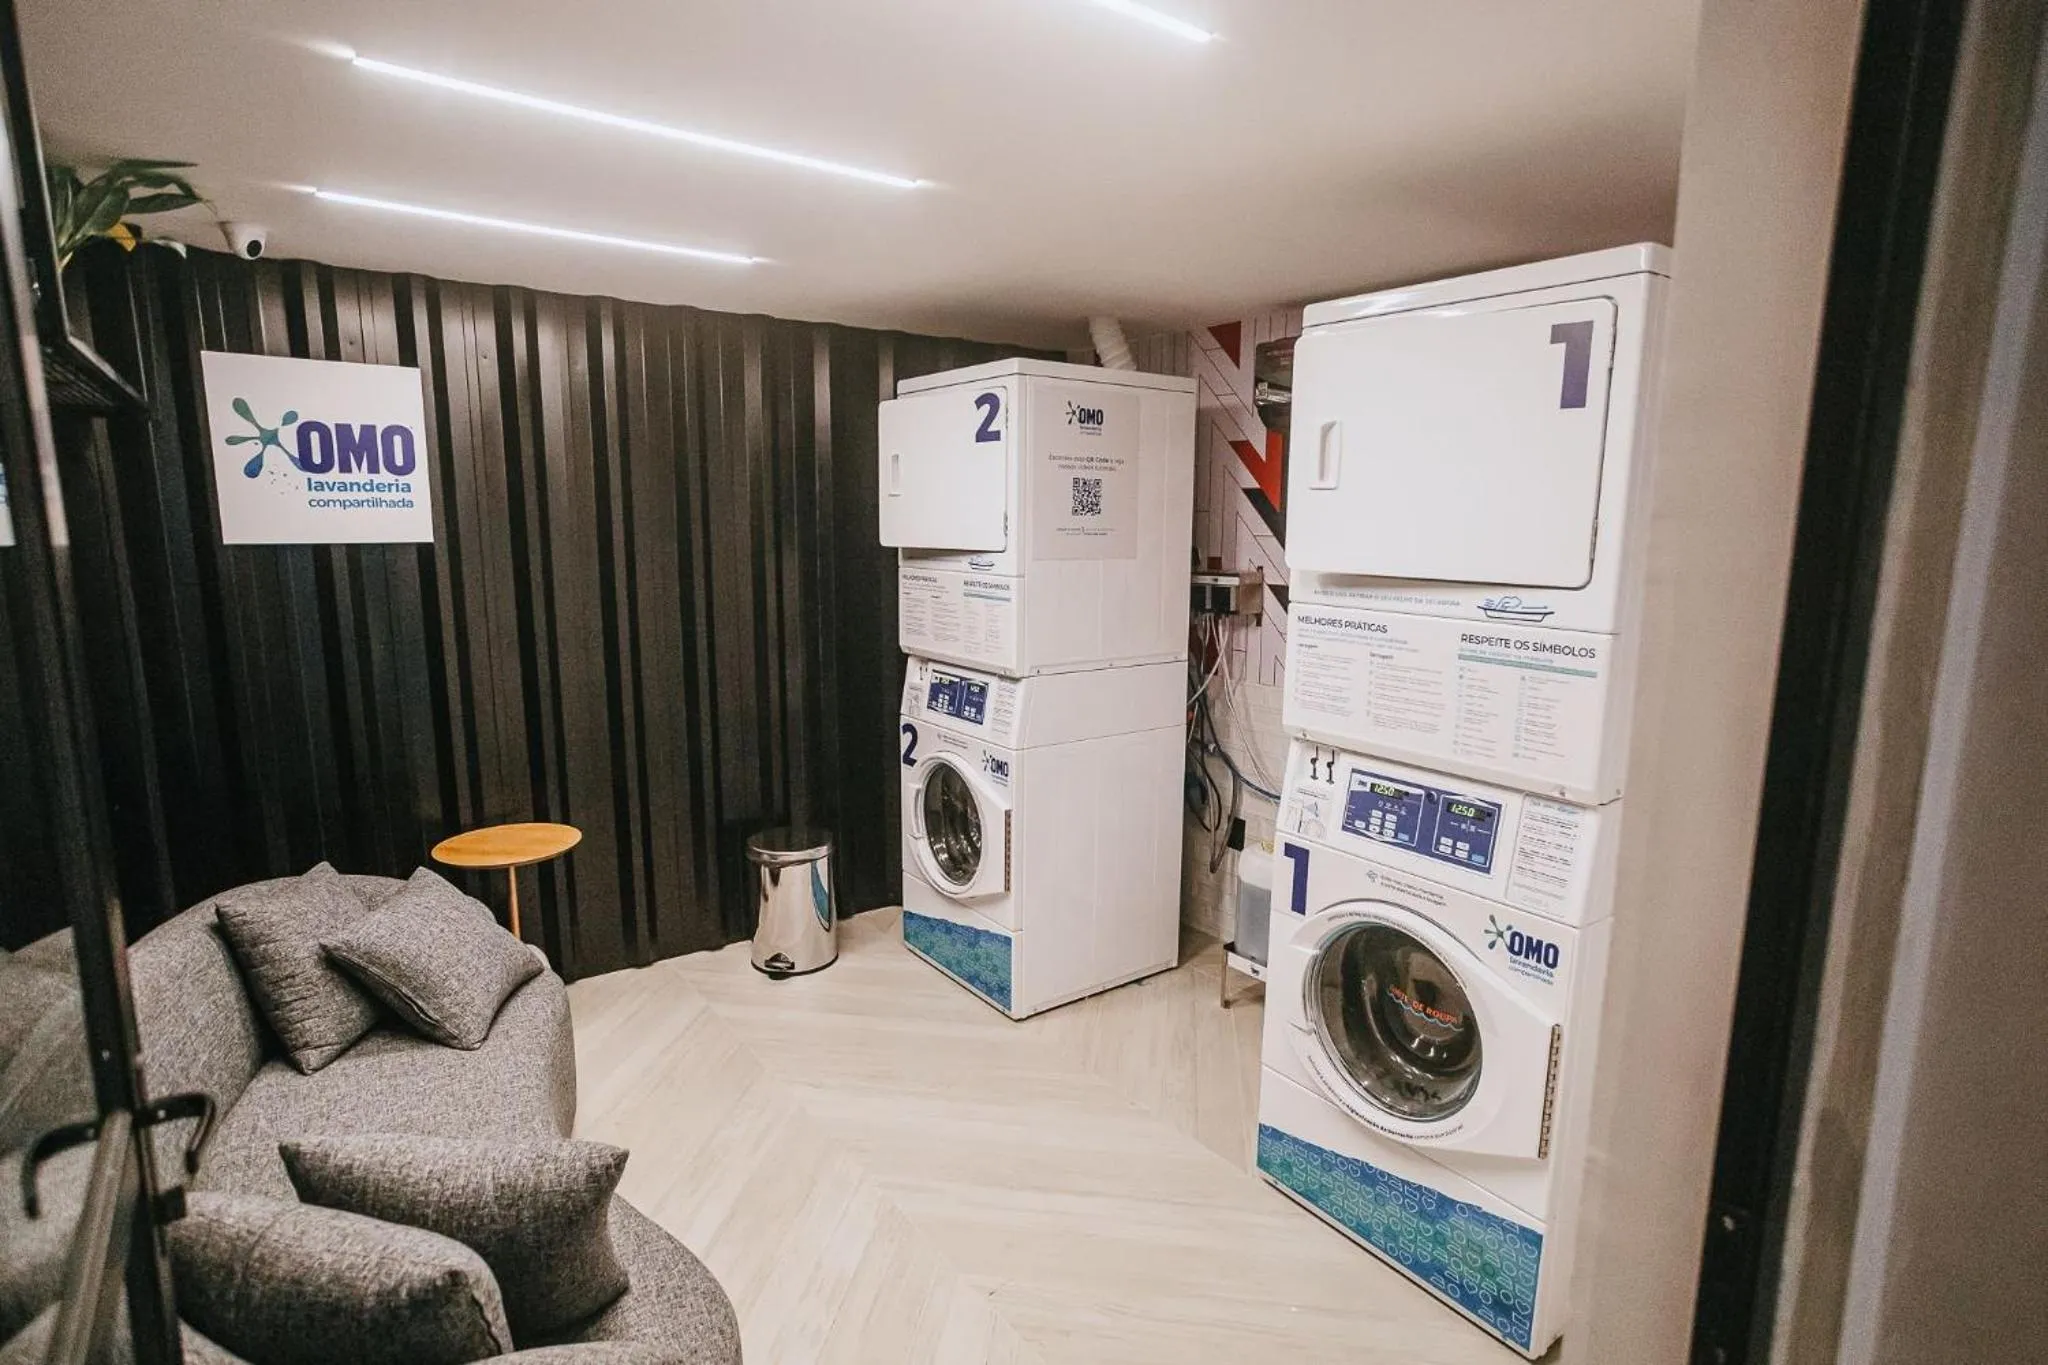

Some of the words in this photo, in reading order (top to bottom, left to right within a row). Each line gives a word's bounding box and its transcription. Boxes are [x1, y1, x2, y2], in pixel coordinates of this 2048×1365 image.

[1550, 320, 1594, 409] 1
[974, 392, 1001, 443] 2
[1078, 408, 1104, 425] OMO
[296, 420, 416, 476] OMO
[306, 477, 412, 493] lavanderia
[308, 497, 415, 510] compartilhada
[1297, 615, 1343, 629] MELHORES
[1460, 633, 1511, 649] RESPEITE
[1513, 639, 1530, 651] OS
[901, 722, 919, 768] 2
[1451, 803, 1476, 817] 1250
[1284, 842, 1311, 917] 1
[1508, 930, 1560, 970] OMO
